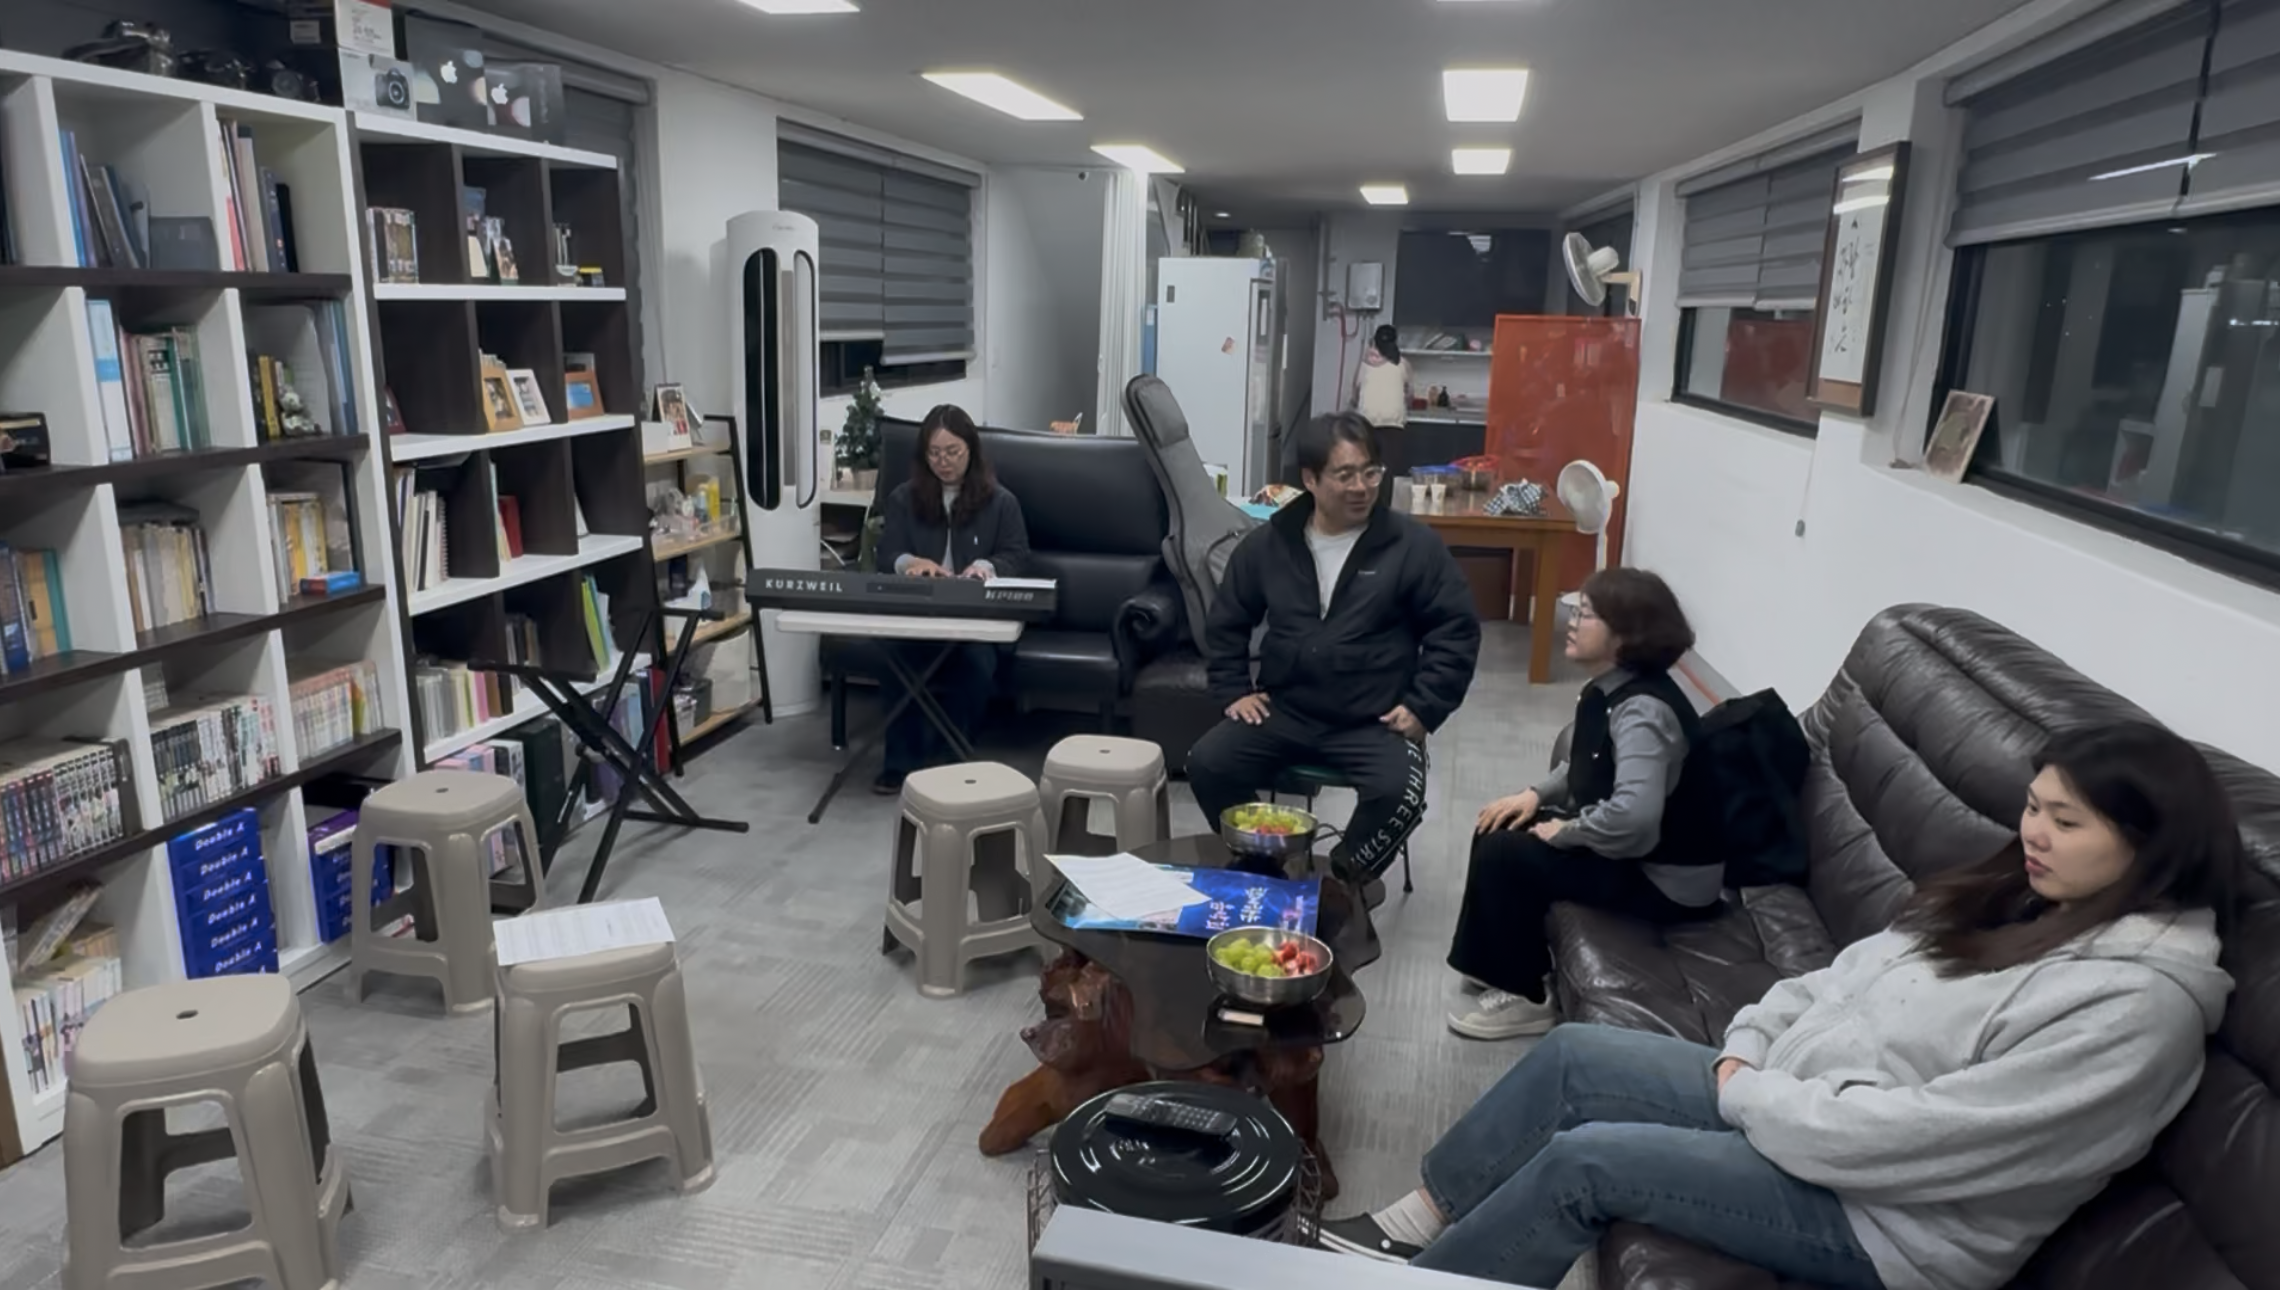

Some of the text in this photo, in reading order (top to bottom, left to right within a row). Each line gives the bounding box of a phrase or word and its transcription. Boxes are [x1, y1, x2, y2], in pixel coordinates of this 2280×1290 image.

[765, 577, 843, 593] KURZWEIL
[1388, 765, 1423, 829] THREE
[195, 821, 245, 851] Double A
[1350, 829, 1392, 866] STRI
[201, 846, 249, 876] Double A
[204, 871, 252, 901] Double A
[208, 894, 256, 925] Double A
[211, 917, 258, 949] Double A
[215, 941, 262, 973] Double A
